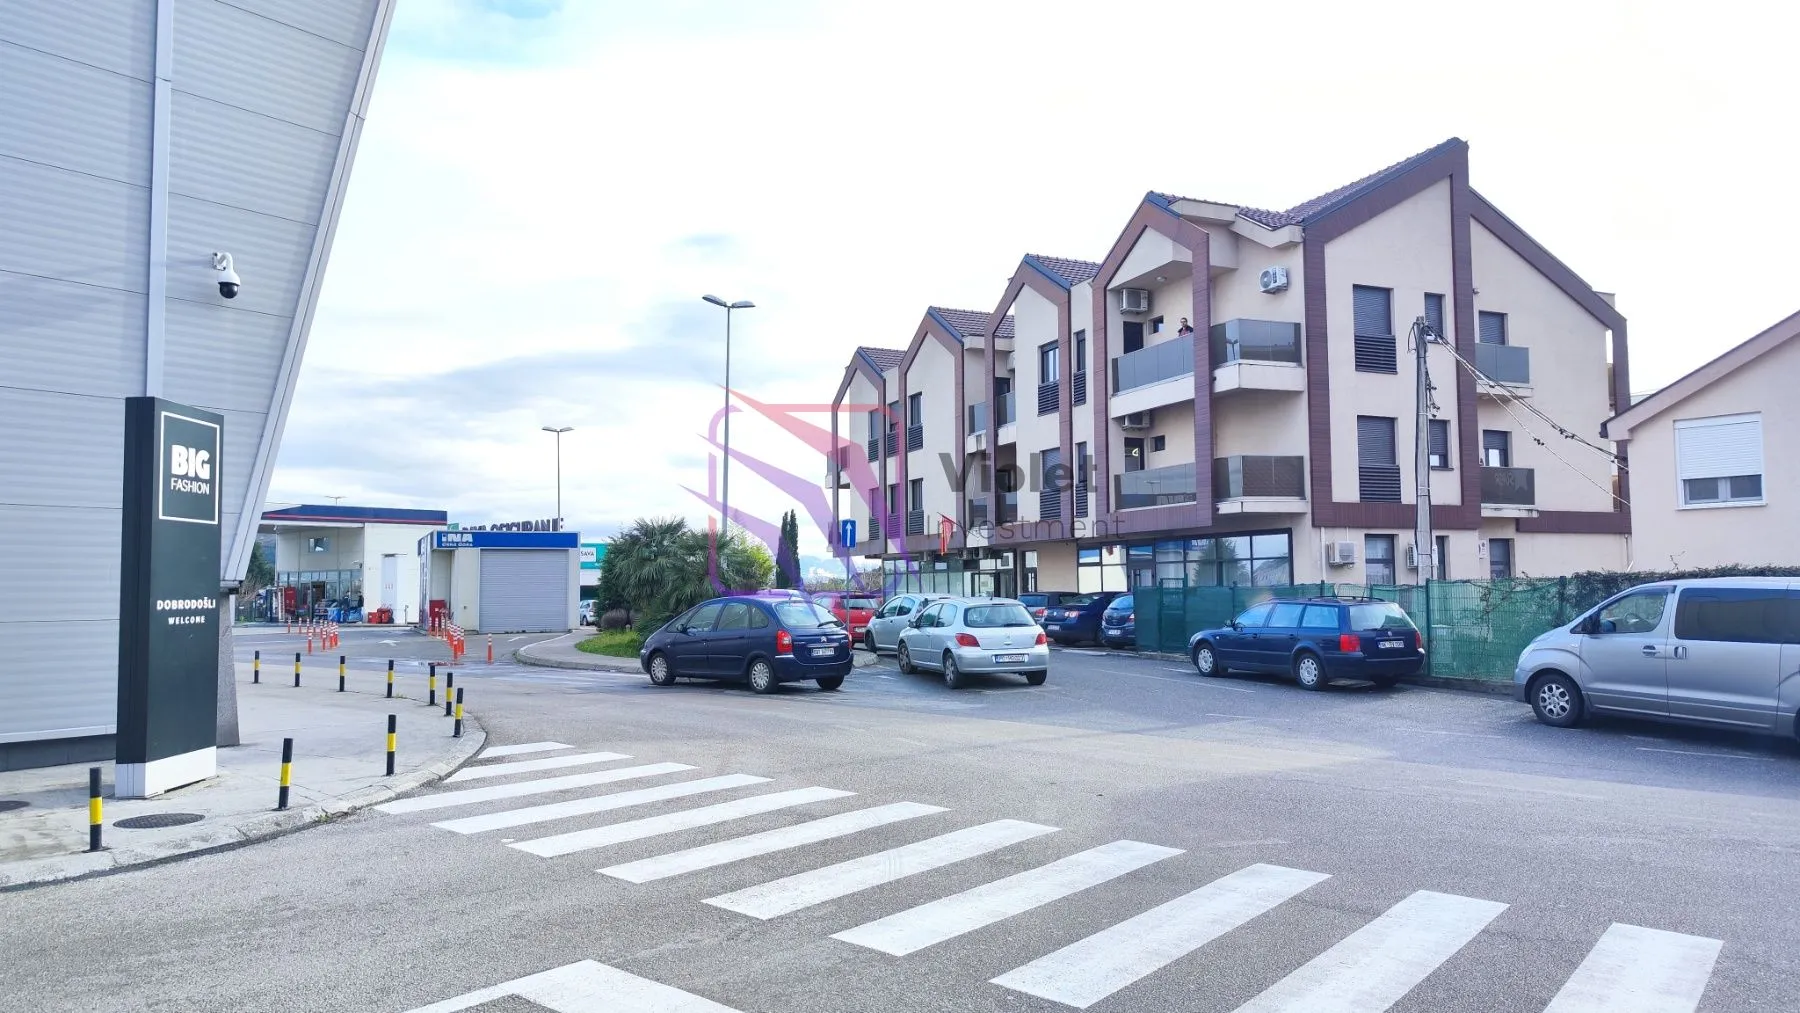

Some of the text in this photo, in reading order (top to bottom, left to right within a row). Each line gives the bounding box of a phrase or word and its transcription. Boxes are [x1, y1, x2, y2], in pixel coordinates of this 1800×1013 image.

[171, 444, 210, 480] BIG
[170, 477, 210, 495] FASHION
[156, 596, 216, 610] DOBRODOŠLI
[168, 615, 206, 625] WELCOME
